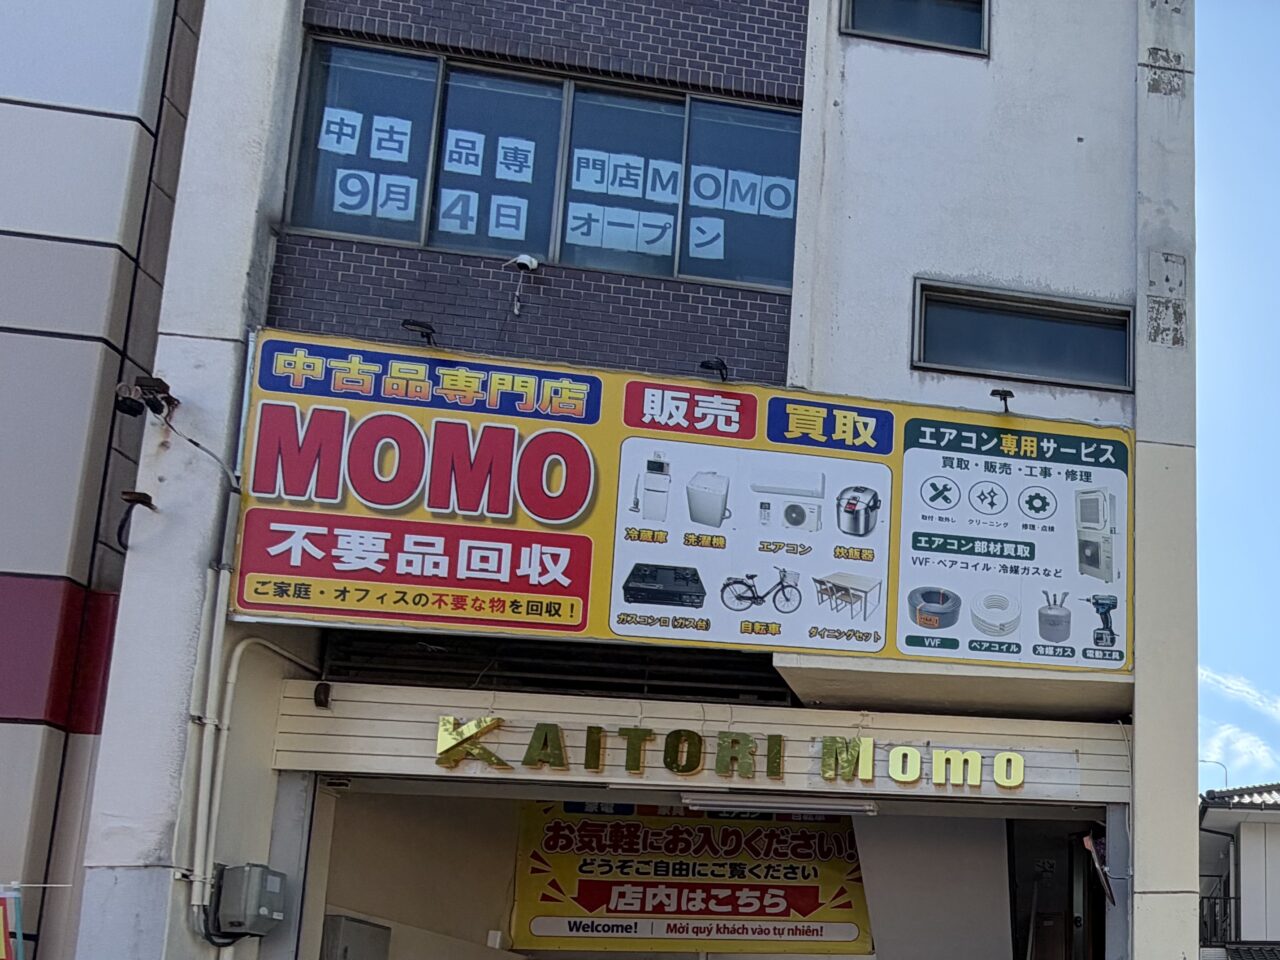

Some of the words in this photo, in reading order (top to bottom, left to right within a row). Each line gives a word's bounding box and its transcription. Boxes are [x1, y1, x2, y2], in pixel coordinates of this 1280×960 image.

[273, 347, 590, 418] 中古品専門店
[641, 387, 742, 433] 販売
[783, 403, 879, 449] 買取
[918, 426, 1116, 464] エアコン専用サービス
[250, 401, 595, 523] MOMO
[624, 527, 669, 544] 冷蔵庫
[967, 518, 1009, 529] クリーニング
[266, 522, 573, 587] 不要品回収
[758, 541, 813, 555] エアコン
[916, 535, 1031, 558] エアコン部材買取
[740, 621, 781, 636] 自転車
[923, 637, 942, 647] VVF
[435, 716, 784, 781] KAITORI
[820, 735, 1026, 788] Momo
[541, 818, 860, 862] お気軽にお入りください!
[577, 858, 819, 881] どうぞご自由にご覧ください
[608, 883, 789, 914] 店内はこちら
[567, 920, 638, 934] Welcome!
[691, 923, 713, 938] quý
[715, 923, 749, 936] khách
[750, 924, 771, 936] vào
